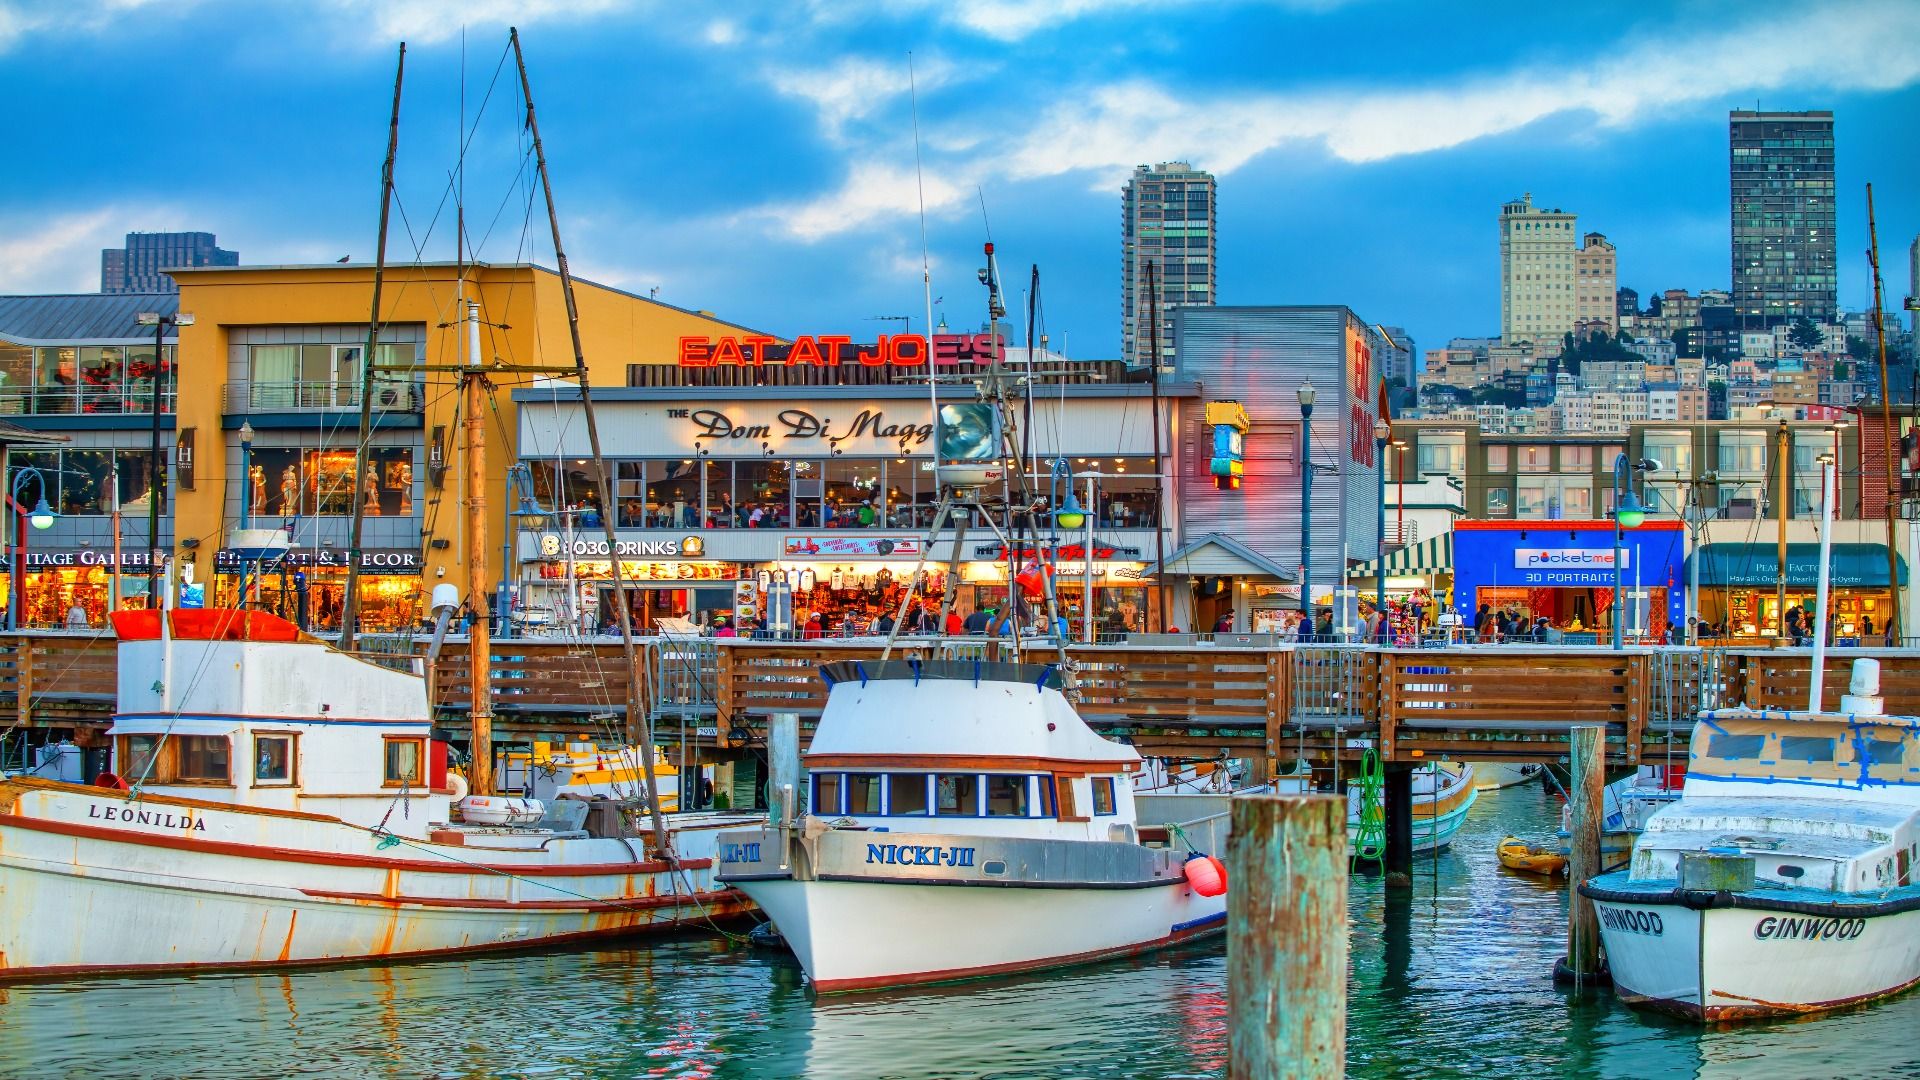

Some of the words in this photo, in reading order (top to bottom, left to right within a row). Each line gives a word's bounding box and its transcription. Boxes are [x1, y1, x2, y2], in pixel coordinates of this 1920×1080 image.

[680, 335, 774, 367] EAT
[785, 335, 851, 367] AT
[859, 334, 1006, 366] JOE'S
[667, 409, 689, 419] THE
[691, 409, 771, 439] Dom
[778, 409, 830, 438] Di
[828, 409, 934, 445] Magg
[319, 551, 338, 566] &
[615, 541, 678, 555] DRINKS
[1526, 573, 1542, 582] 3D
[1547, 573, 1615, 582] PORTRAITS
[1756, 563, 1780, 572] PEAR
[1789, 563, 1836, 572] FACTOY
[1354, 740, 1365, 748] 28
[88, 804, 206, 831] LEONILDA
[721, 843, 761, 863] KI-JII
[866, 843, 976, 867] NICKI-JII
[1600, 905, 1663, 936] GINWOOD
[1756, 916, 1867, 940] GINWOOD
